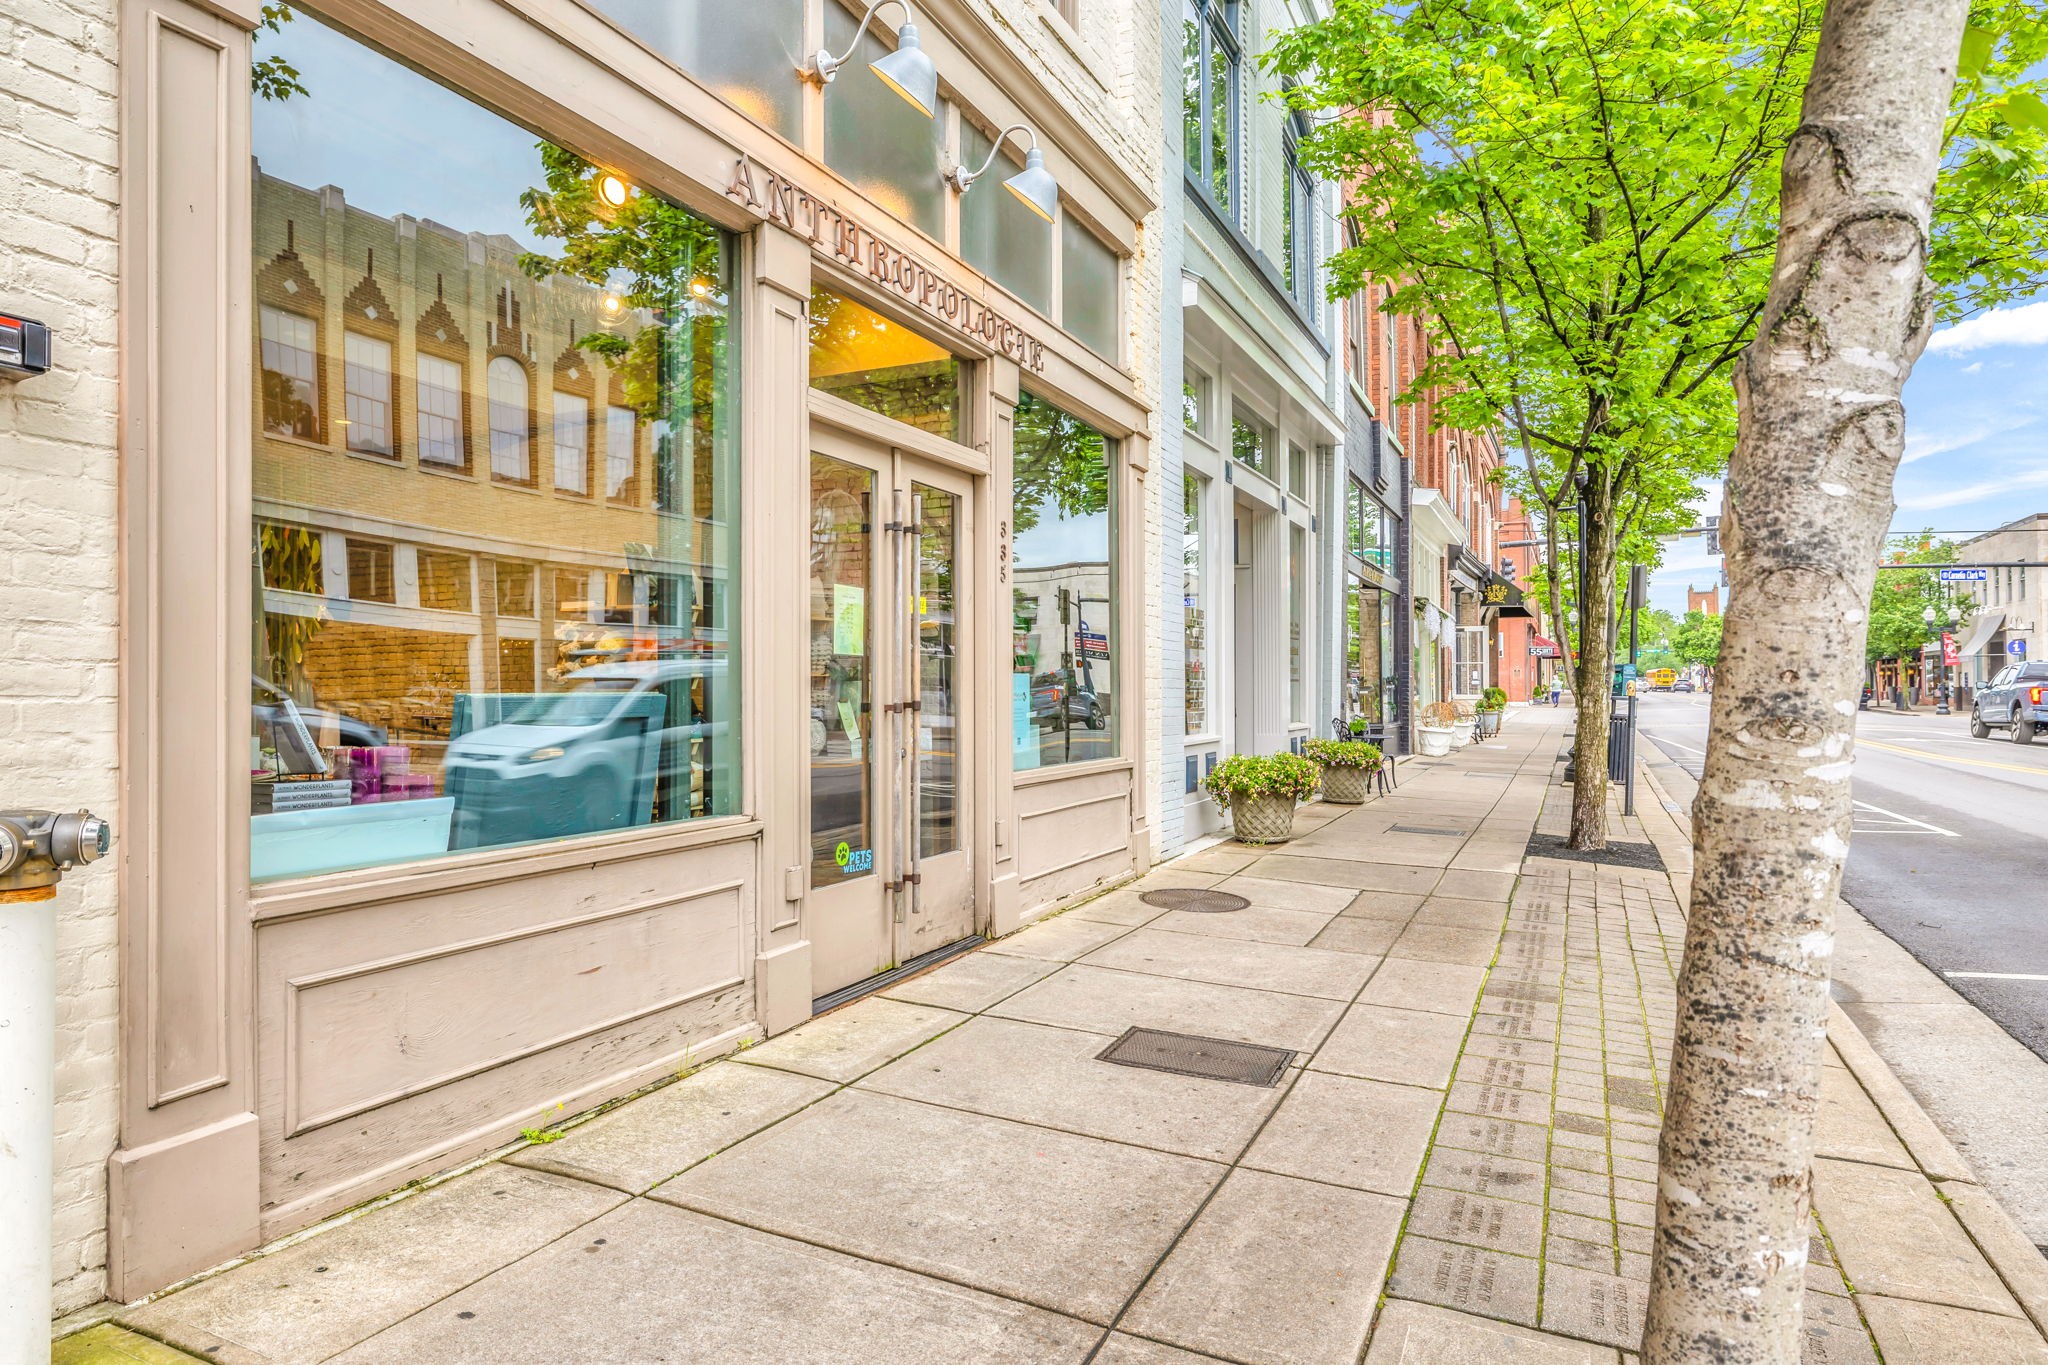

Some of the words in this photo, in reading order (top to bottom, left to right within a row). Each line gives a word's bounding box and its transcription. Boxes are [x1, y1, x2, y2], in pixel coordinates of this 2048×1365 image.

[726, 154, 1044, 372] ANTHROPOLOGIE
[849, 849, 872, 864] PETS
[843, 862, 872, 873] WELCOME
